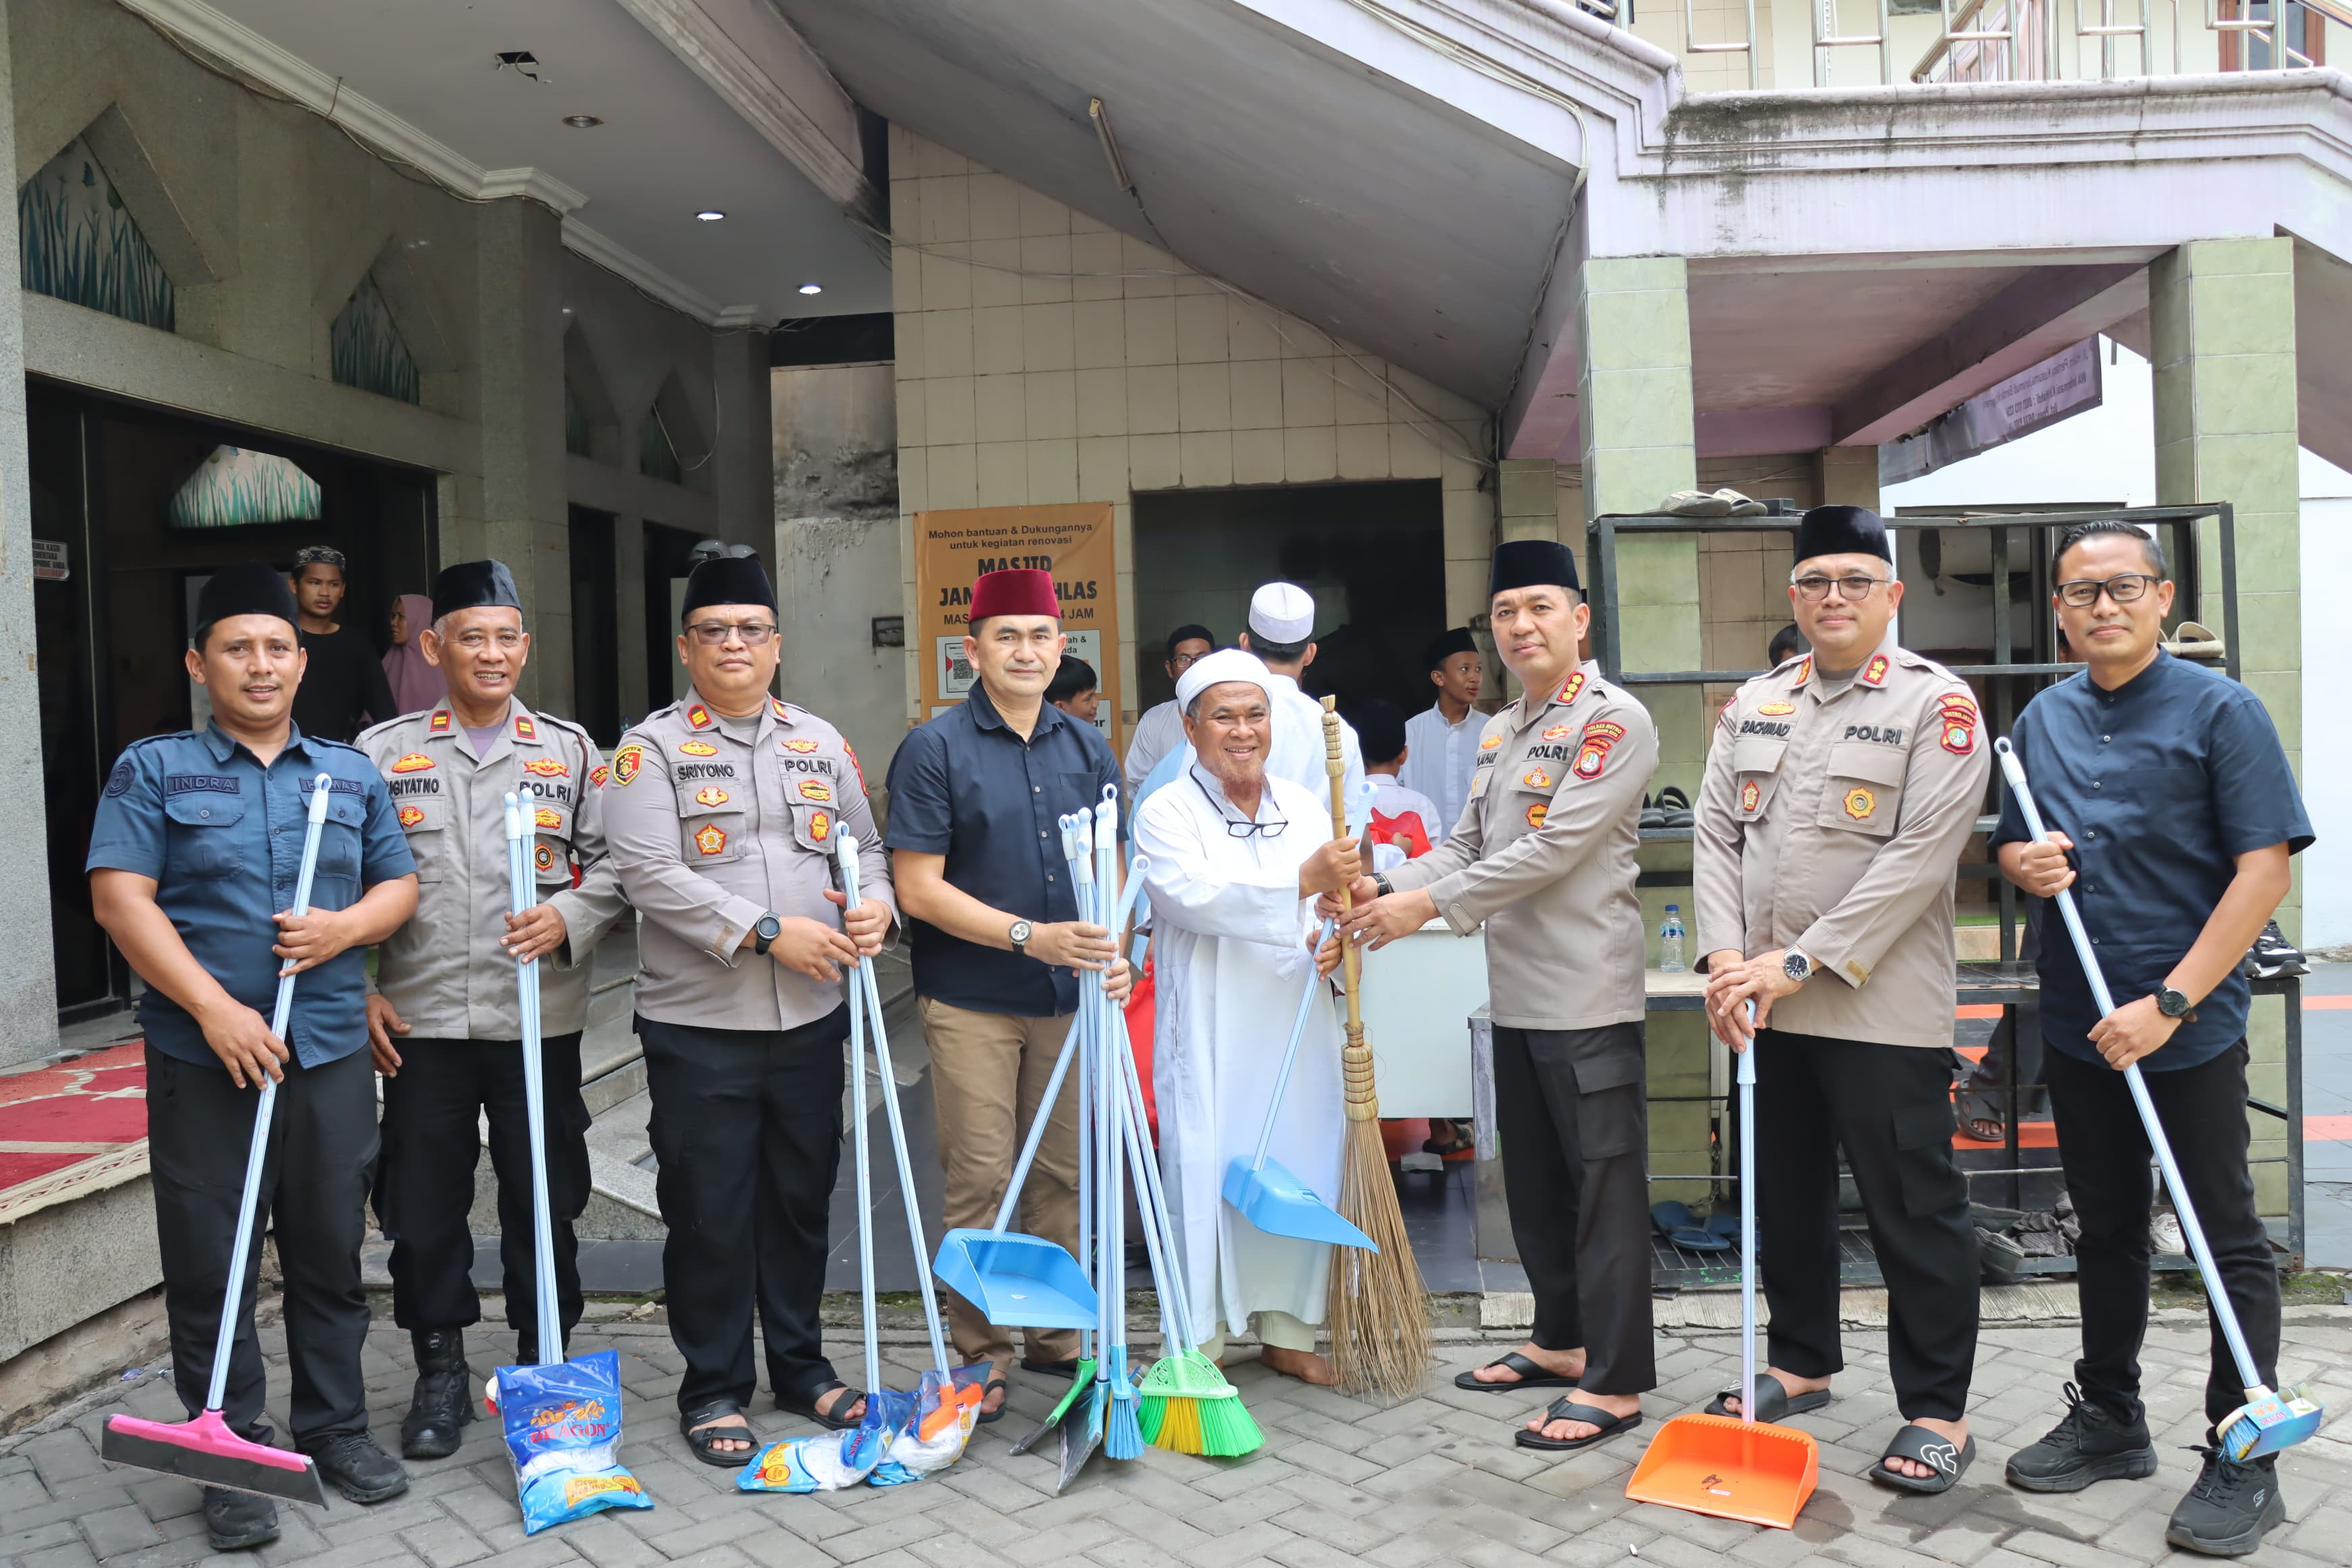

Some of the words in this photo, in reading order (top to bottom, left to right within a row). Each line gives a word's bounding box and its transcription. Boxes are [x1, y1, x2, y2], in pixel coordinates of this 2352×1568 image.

[929, 529, 963, 539] Mohon
[966, 526, 1007, 537] bantuan
[1010, 526, 1018, 535] &
[1021, 523, 1093, 535] Dukungannya
[950, 539, 979, 549] untuk
[981, 537, 1025, 549] kegiatan
[1027, 535, 1072, 546] renovasi
[978, 556, 1052, 577] MASJID
[1056, 581, 1097, 600] HLAS
[944, 613, 969, 625] MAS
[1069, 608, 1094, 620] JAM
[1587, 723, 1605, 731] POLRES
[1606, 724, 1622, 734] METRO
[1740, 720, 1791, 737] RACHMAD
[1844, 725, 1903, 744] POLRI
[1527, 745, 1569, 761] POLRI
[677, 762, 735, 780] SRIYONO
[785, 759, 832, 775] POLRI
[174, 777, 235, 791] INDRA
[308, 781, 359, 791] HMAS
[520, 781, 571, 802] POLRI
[530, 1423, 606, 1444] DRAGON
